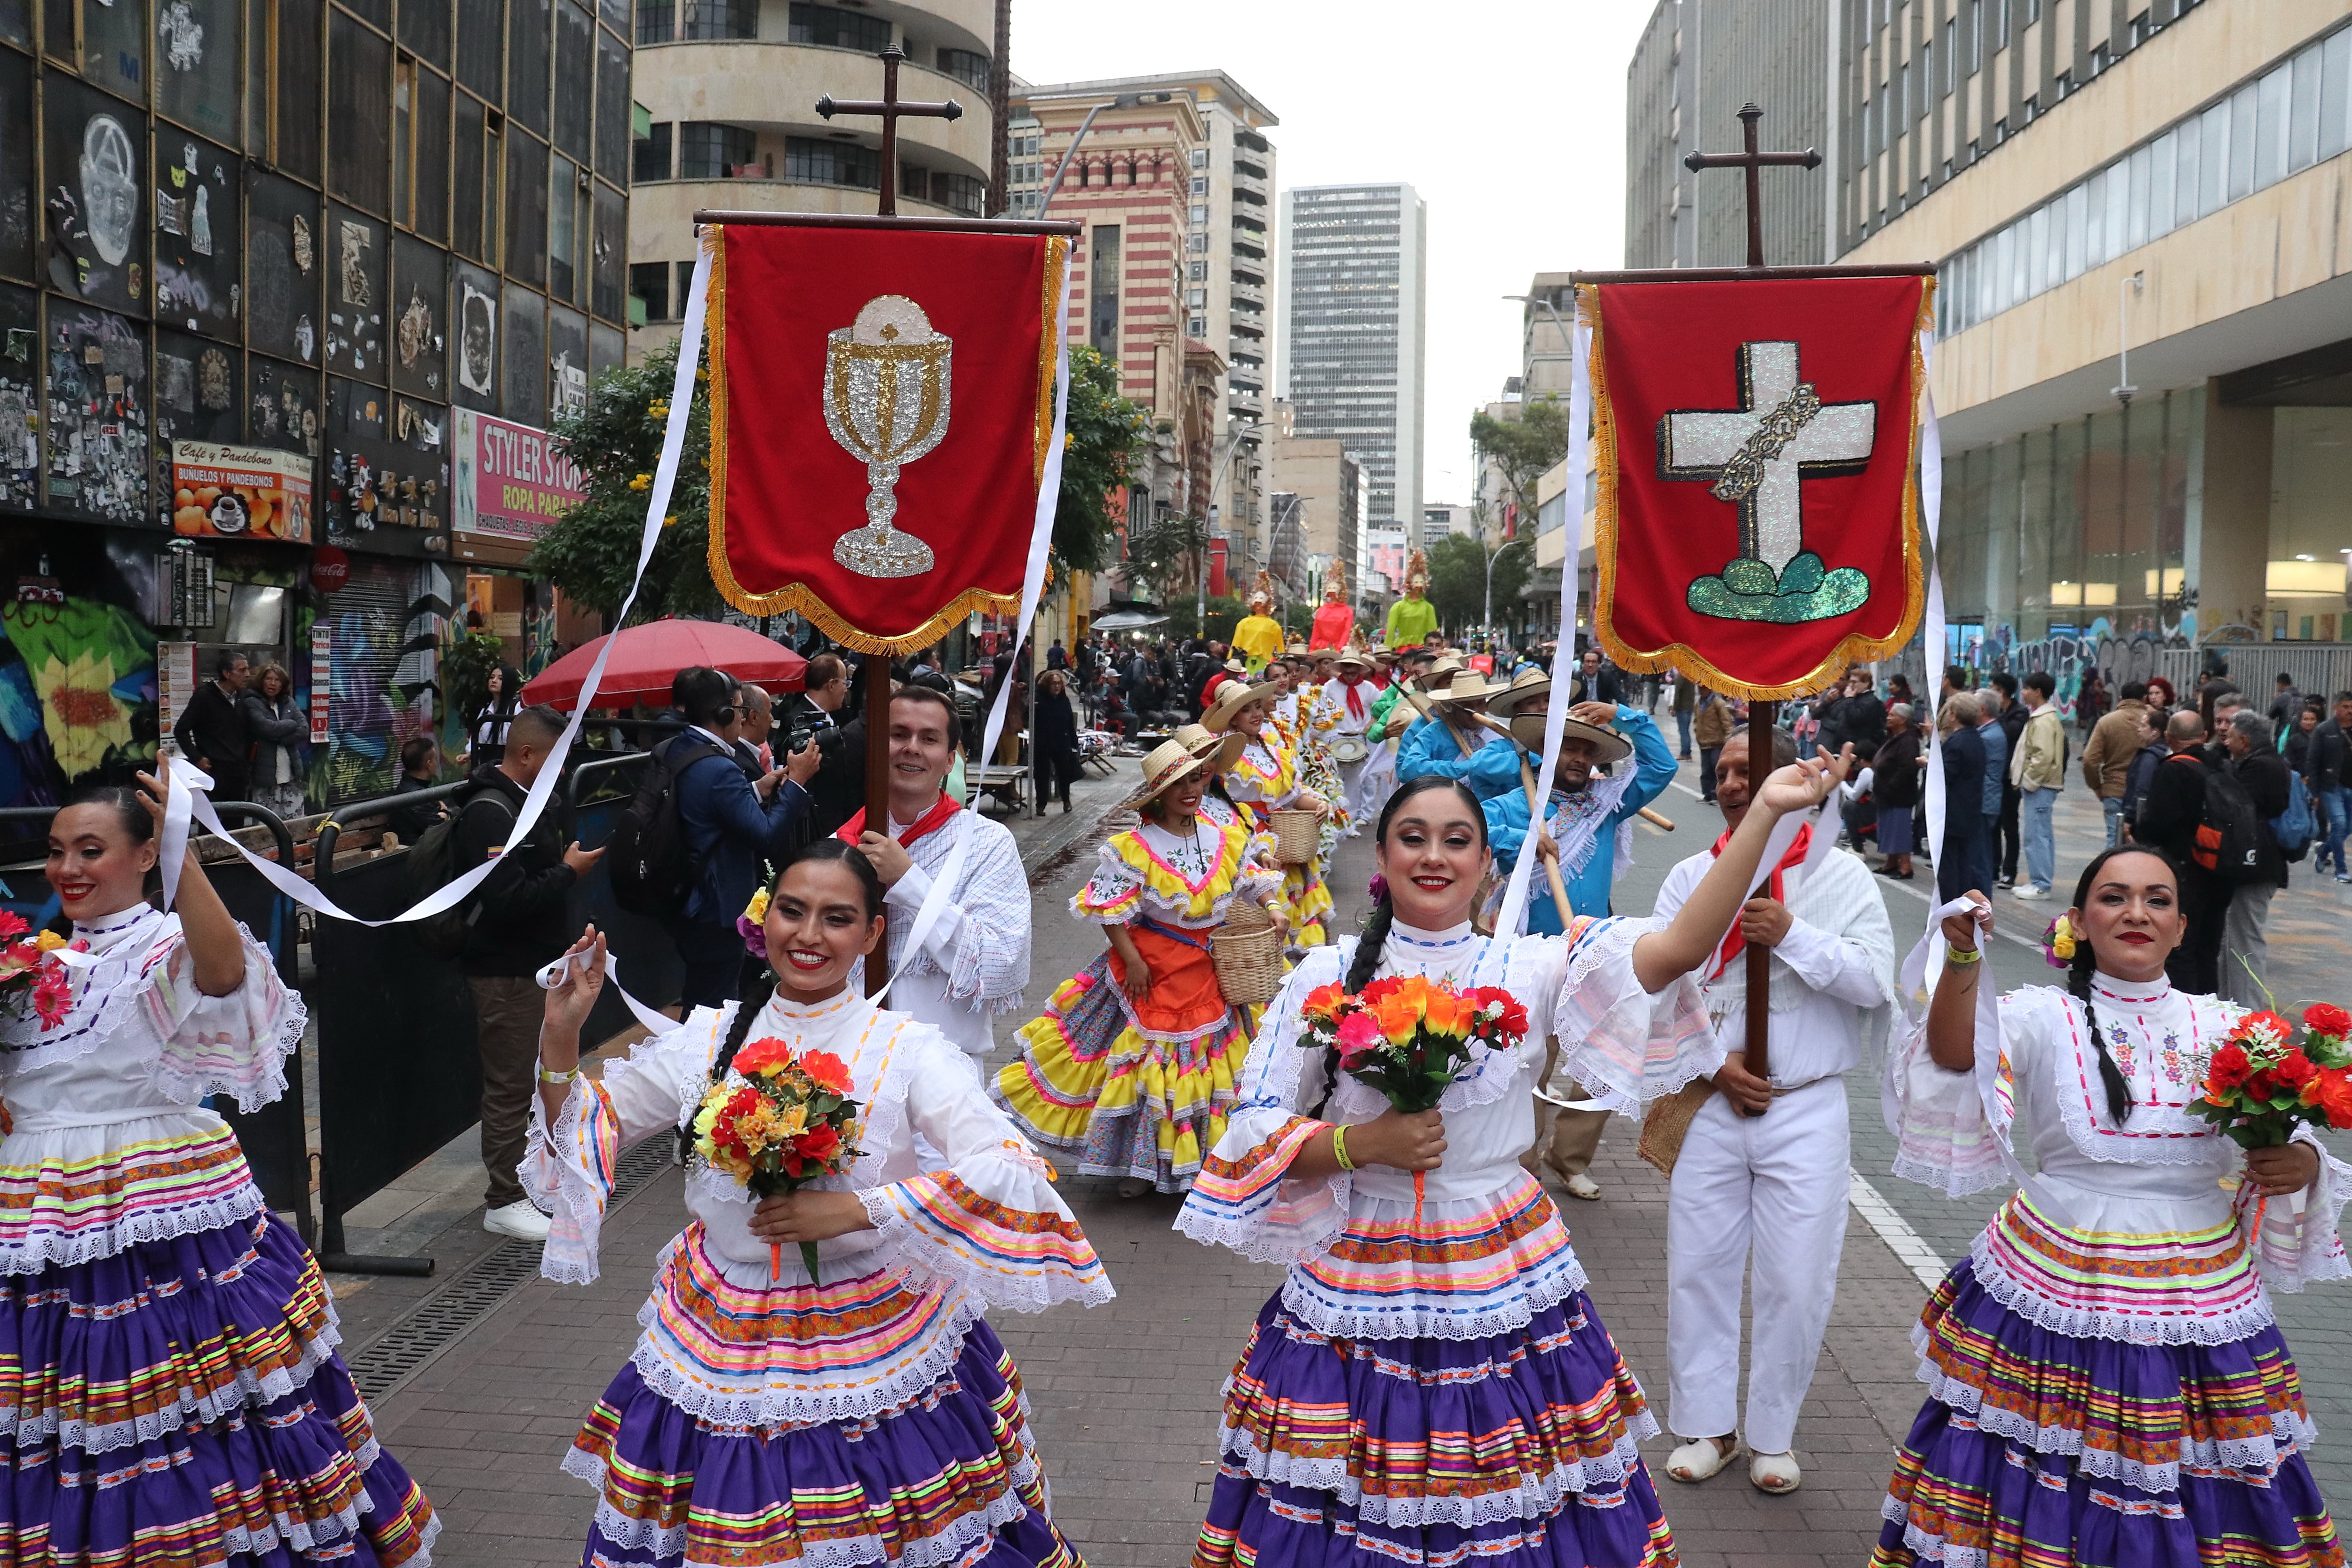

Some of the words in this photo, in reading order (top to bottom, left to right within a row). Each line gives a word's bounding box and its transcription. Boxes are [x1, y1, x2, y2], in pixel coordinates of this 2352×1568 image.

[179, 443, 206, 462] Café
[209, 452, 215, 462] y
[220, 447, 273, 465] Pandebono
[484, 423, 542, 485] STYLER
[178, 467, 218, 483] BUÑUELOS
[219, 471, 225, 484] Y
[226, 472, 274, 488] PANDEBONOS
[502, 484, 535, 514] ROPA
[538, 492, 569, 518] PARA
[312, 630, 329, 639] TINTO
